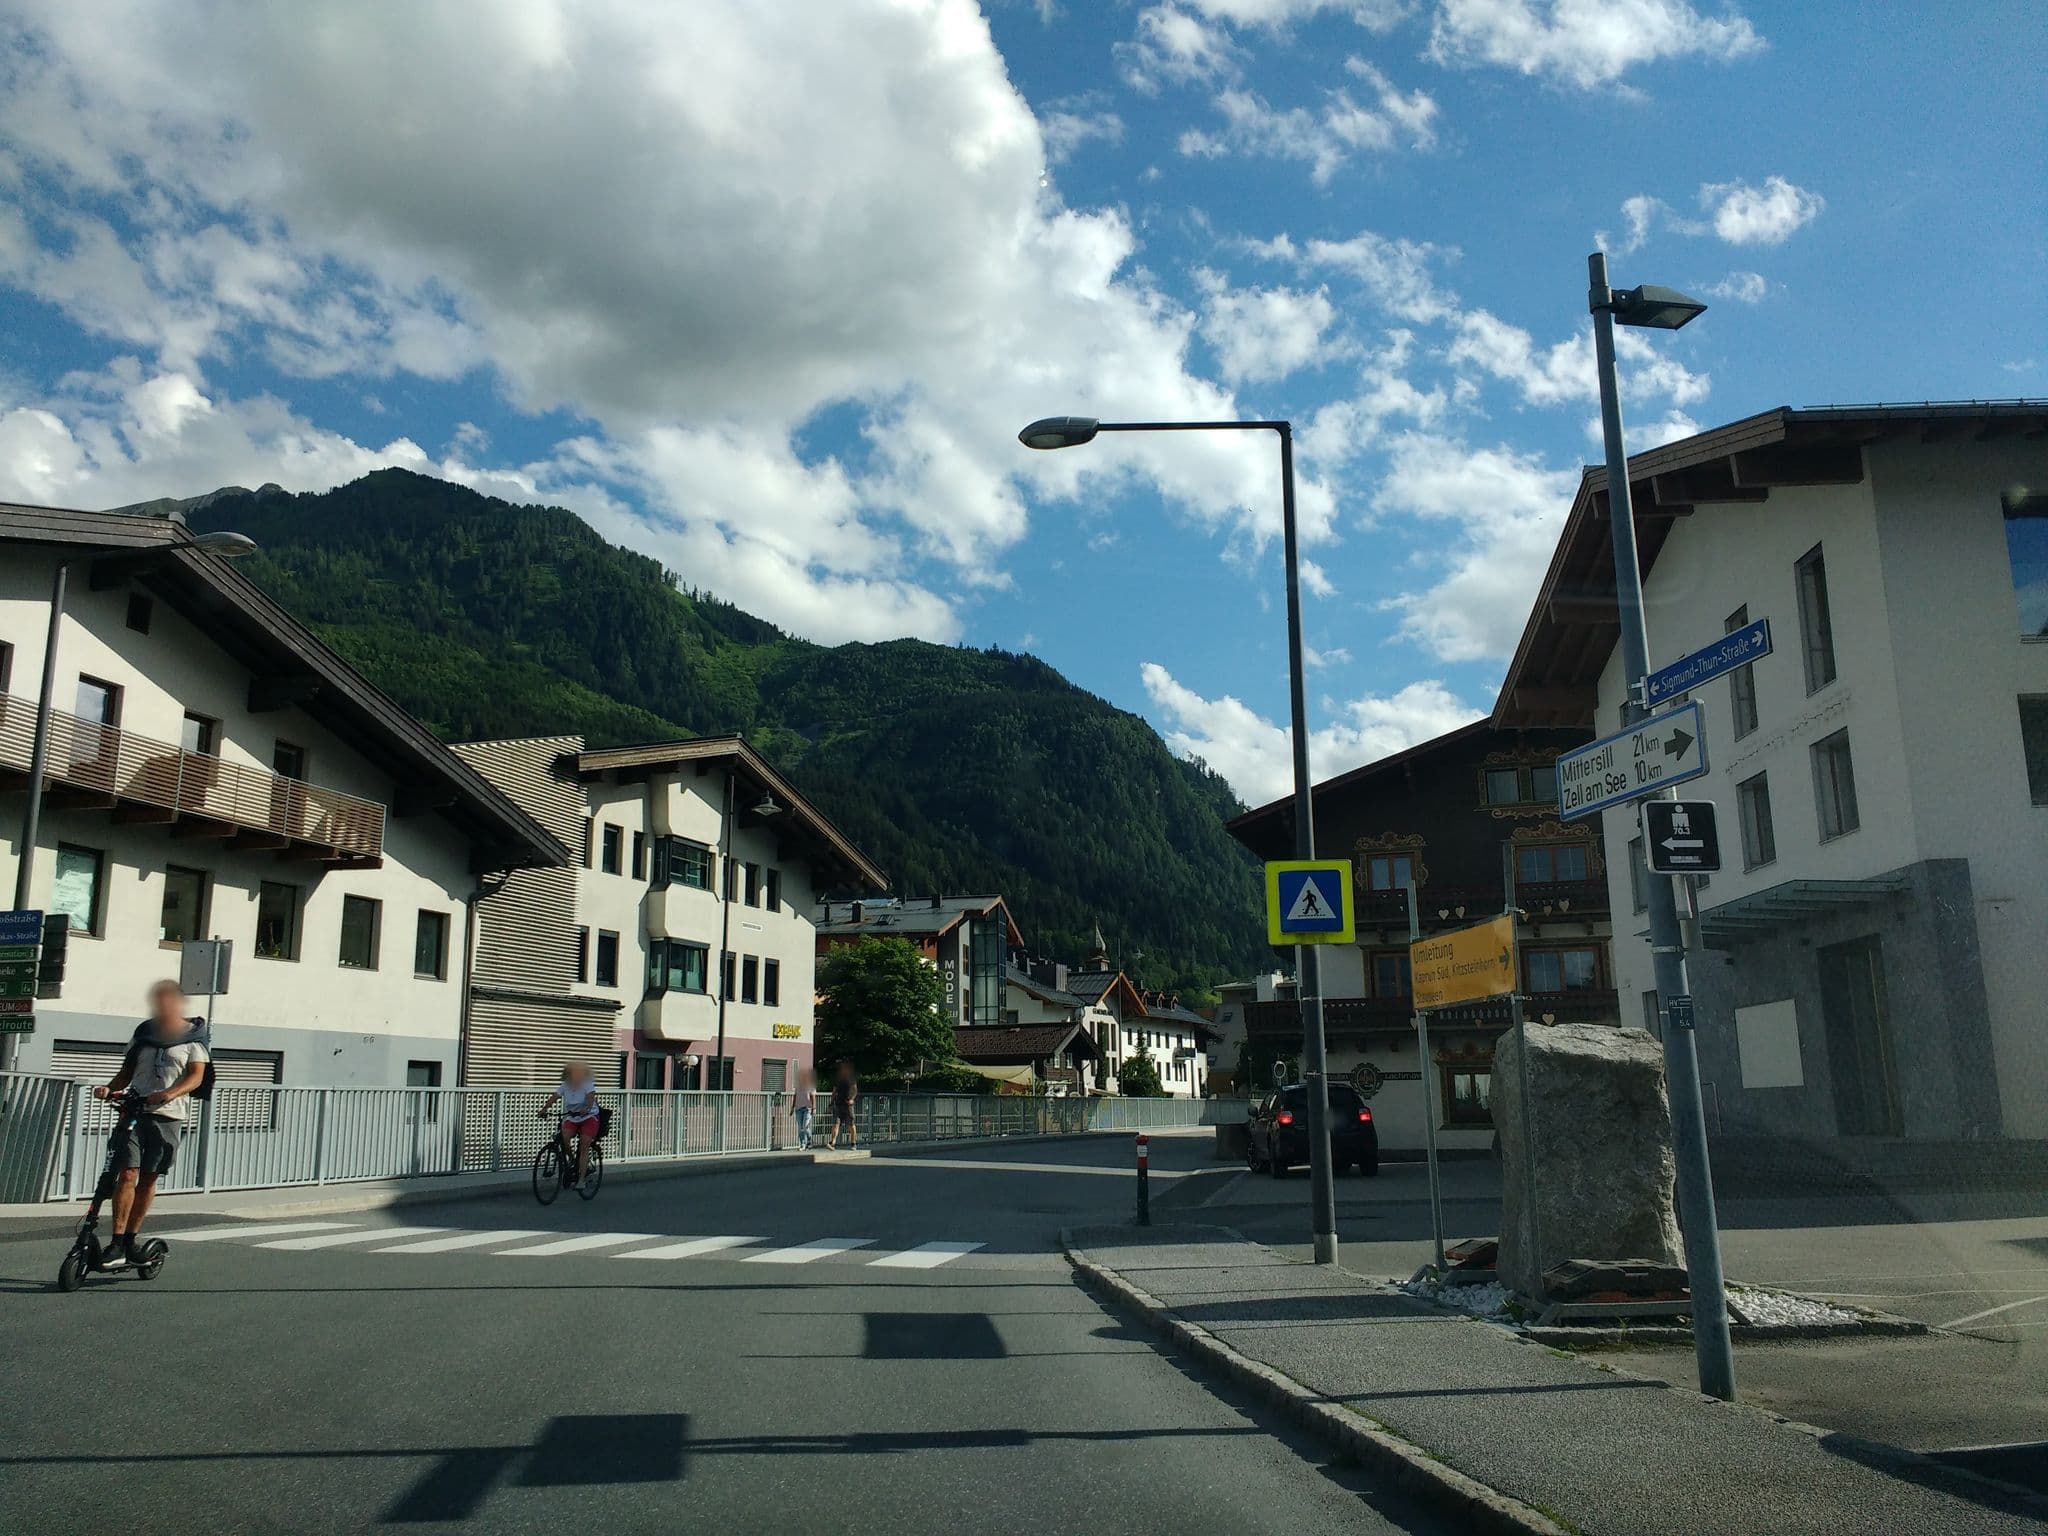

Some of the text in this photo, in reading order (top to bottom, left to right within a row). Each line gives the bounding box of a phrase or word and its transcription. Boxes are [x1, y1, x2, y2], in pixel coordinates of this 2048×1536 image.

[1661, 638, 1750, 692] Sigmund-Thun-Straße
[1562, 733, 1660, 785] Mittersill 21 km
[1564, 760, 1662, 810] Zell am See 10 km
[1673, 827, 1690, 835] 70.3
[1413, 943, 1454, 963] Umleitung
[944, 959, 955, 1004] MODE
[0, 1020, 33, 1030] lroute
